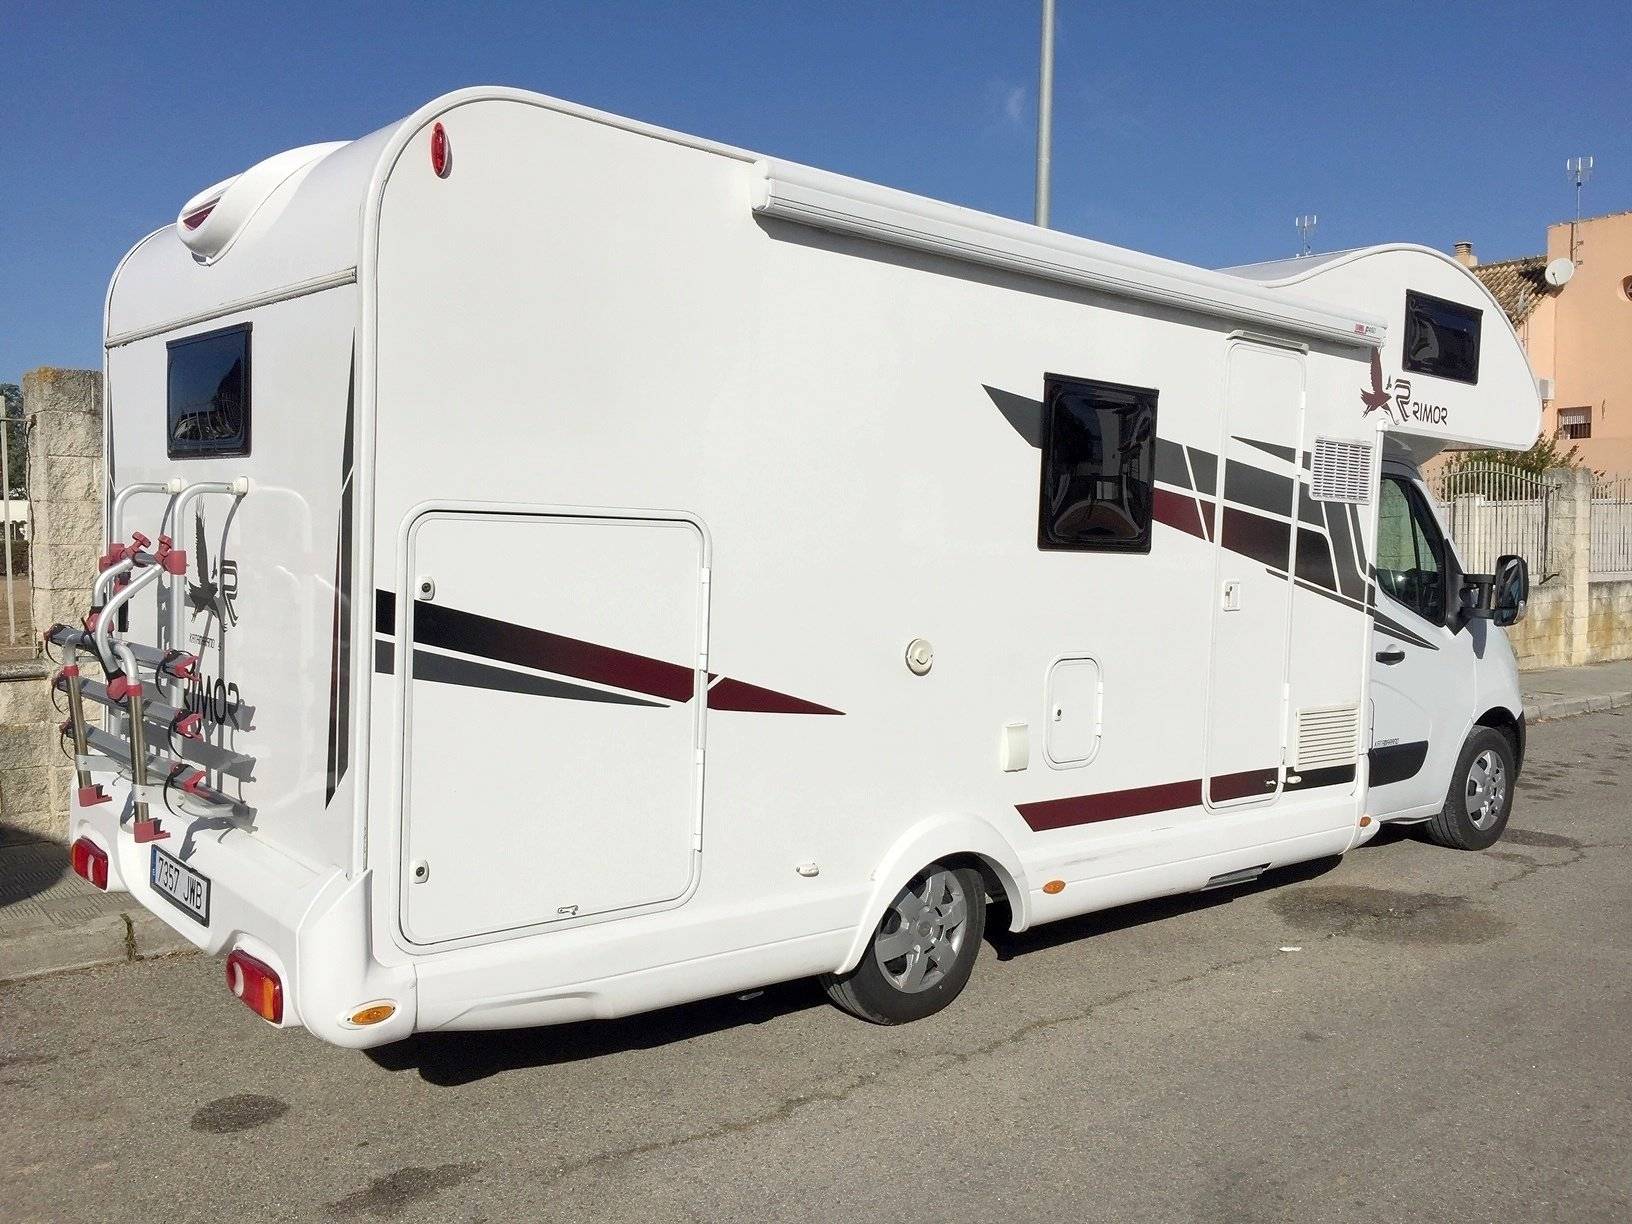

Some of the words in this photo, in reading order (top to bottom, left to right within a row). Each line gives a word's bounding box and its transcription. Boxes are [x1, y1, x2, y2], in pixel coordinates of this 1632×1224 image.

[1413, 402, 1448, 425] RIMOR
[159, 857, 180, 894] 7357
[183, 876, 202, 910] JWB
